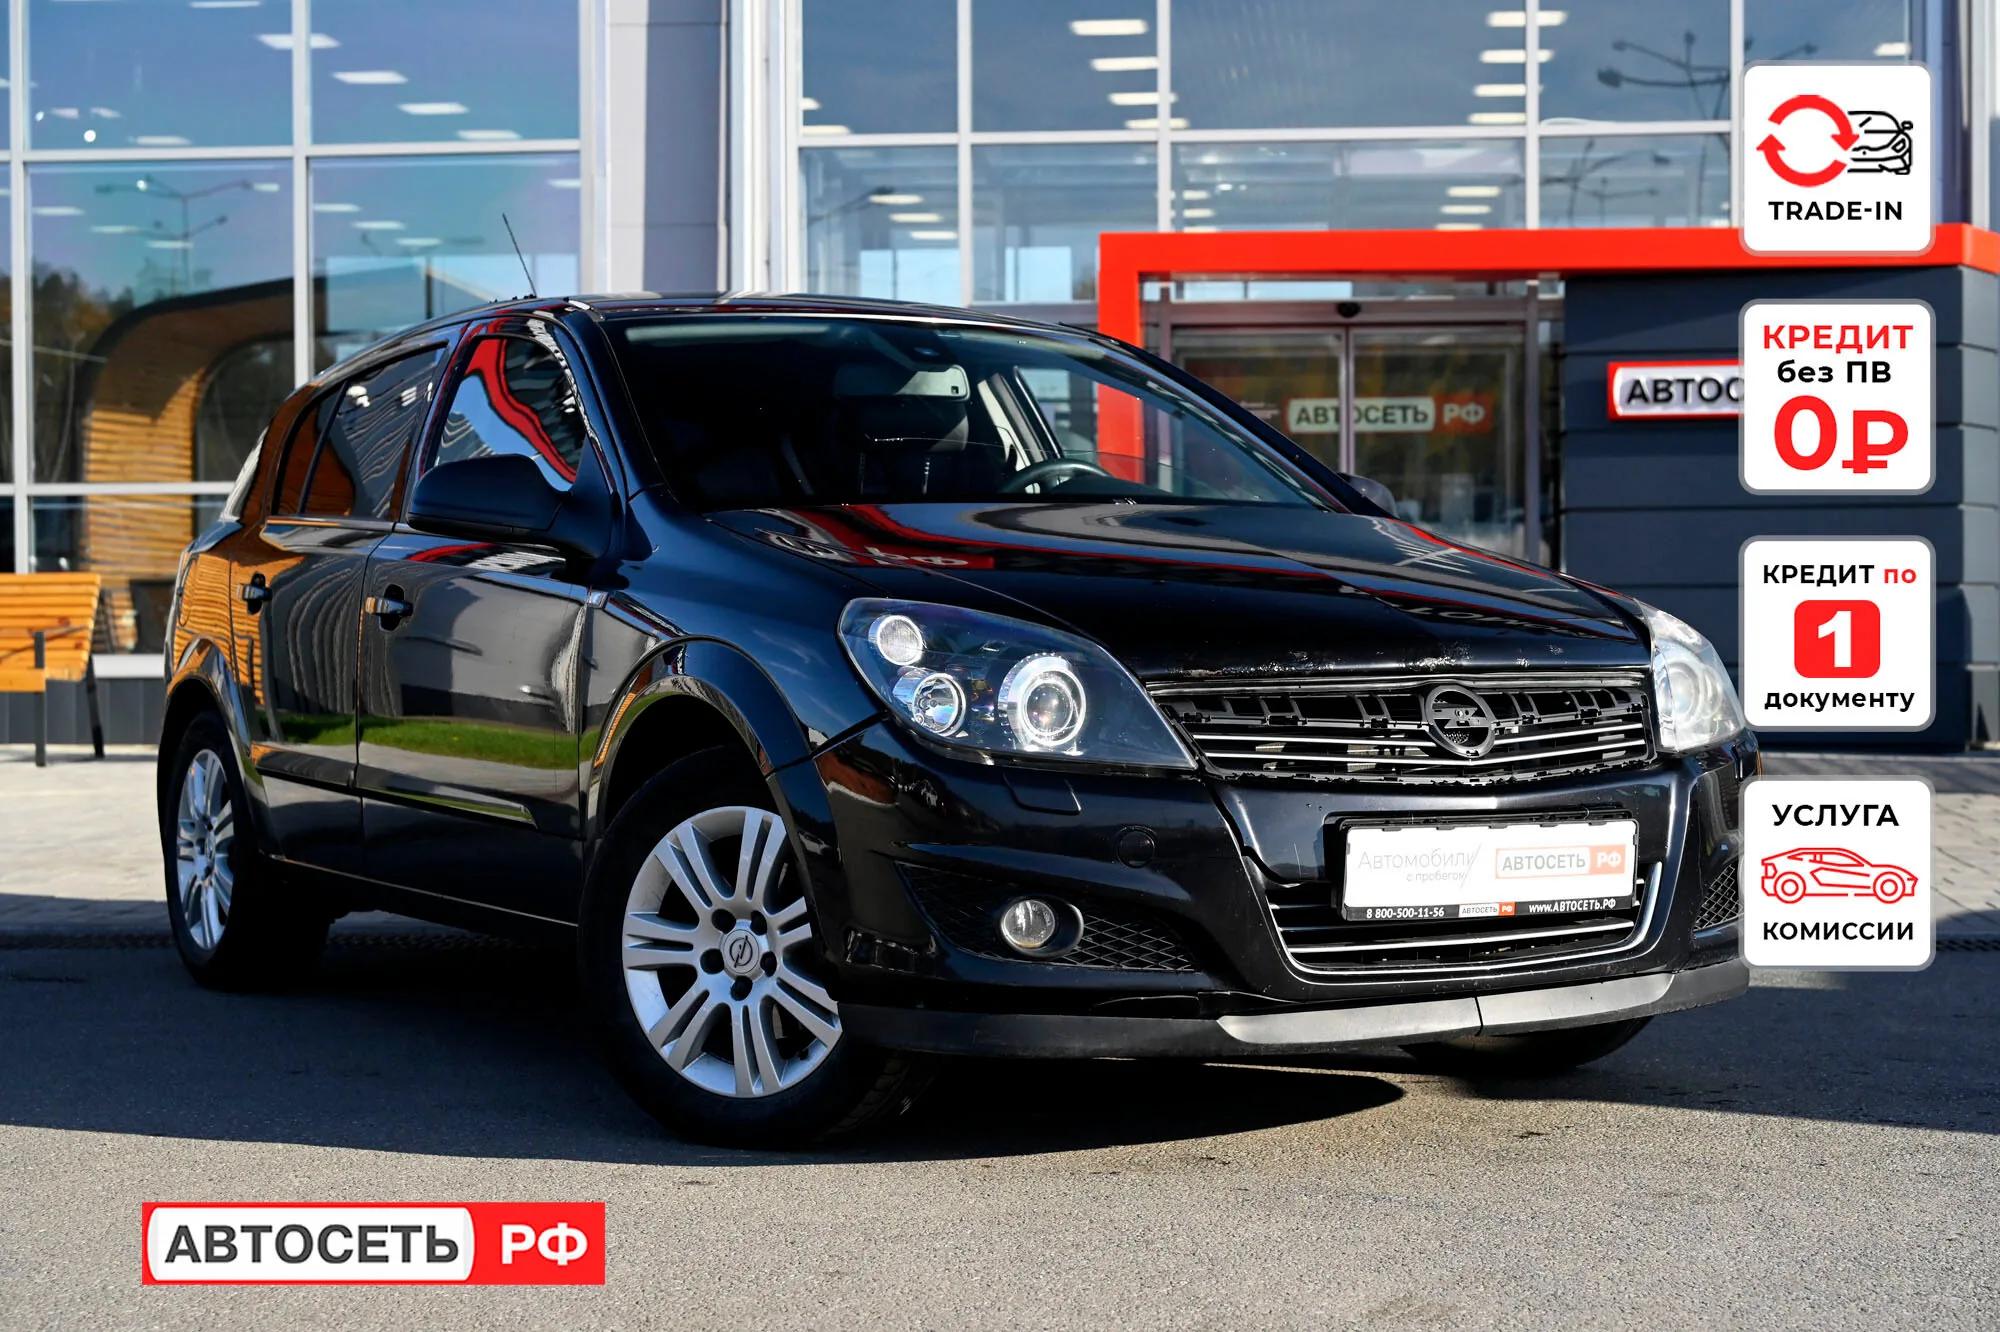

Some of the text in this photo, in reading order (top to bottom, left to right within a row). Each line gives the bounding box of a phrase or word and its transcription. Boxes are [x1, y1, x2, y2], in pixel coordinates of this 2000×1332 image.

[1443, 402, 1486, 425] РФ
[1502, 850, 1622, 872] АВТОСЕТЬ РФ
[1366, 906, 1445, 919] 8 800-500-11-56
[1462, 904, 1513, 914] АВТОСЕТЬ РФ
